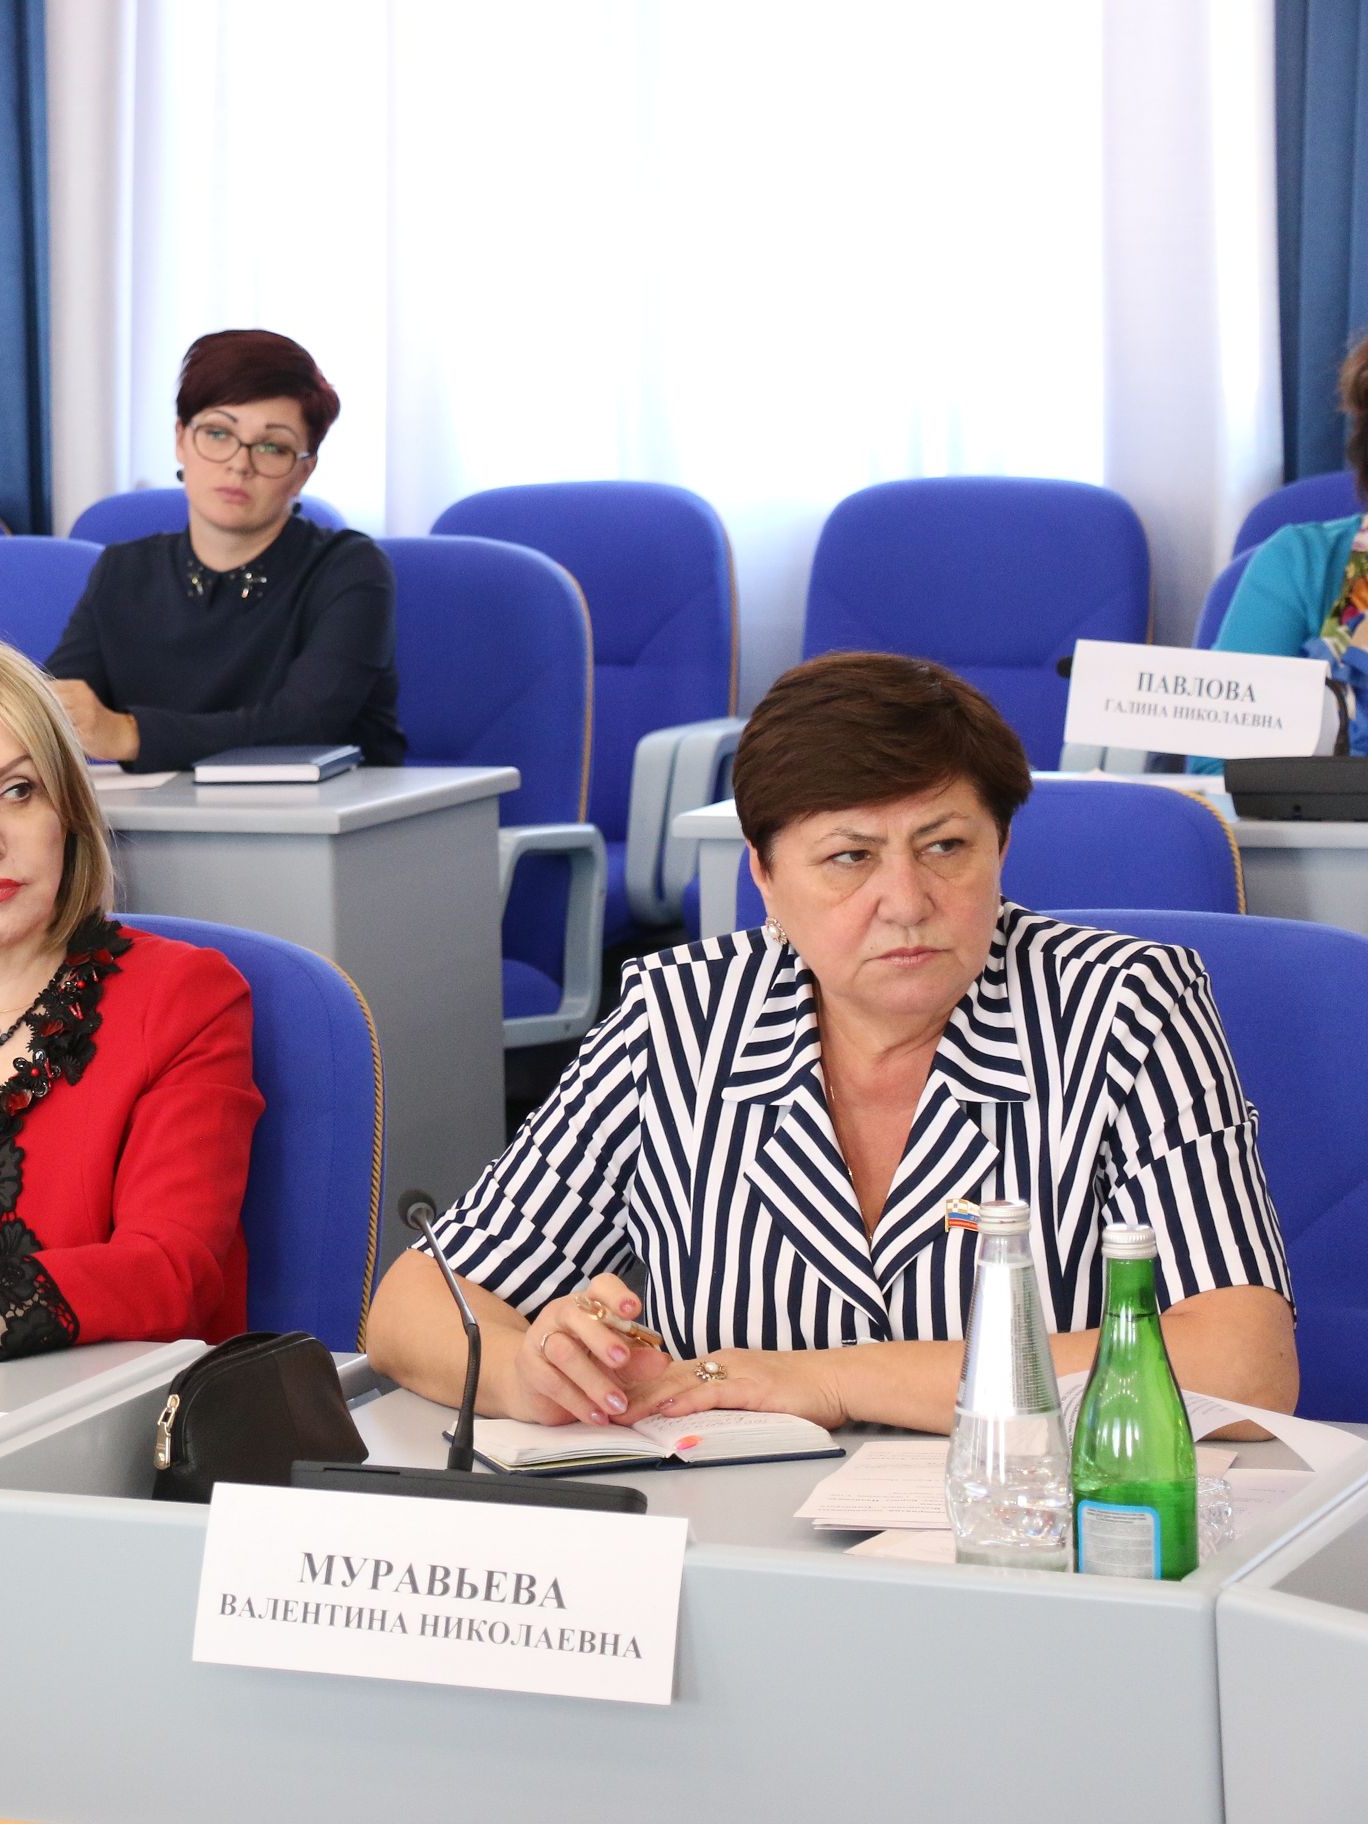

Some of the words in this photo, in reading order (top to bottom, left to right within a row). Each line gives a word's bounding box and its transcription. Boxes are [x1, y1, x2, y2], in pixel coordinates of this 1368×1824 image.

[1136, 671, 1257, 703] ПАВЛОВА
[1104, 698, 1168, 718] ГАЛИНА
[1172, 704, 1284, 730] НИКОЛАЕВНА
[298, 1551, 568, 1610] МУРАВЬЕВА
[218, 1592, 409, 1635] ВАЛЕНТИНА
[418, 1613, 643, 1660] НИКОЛАЕВНА
